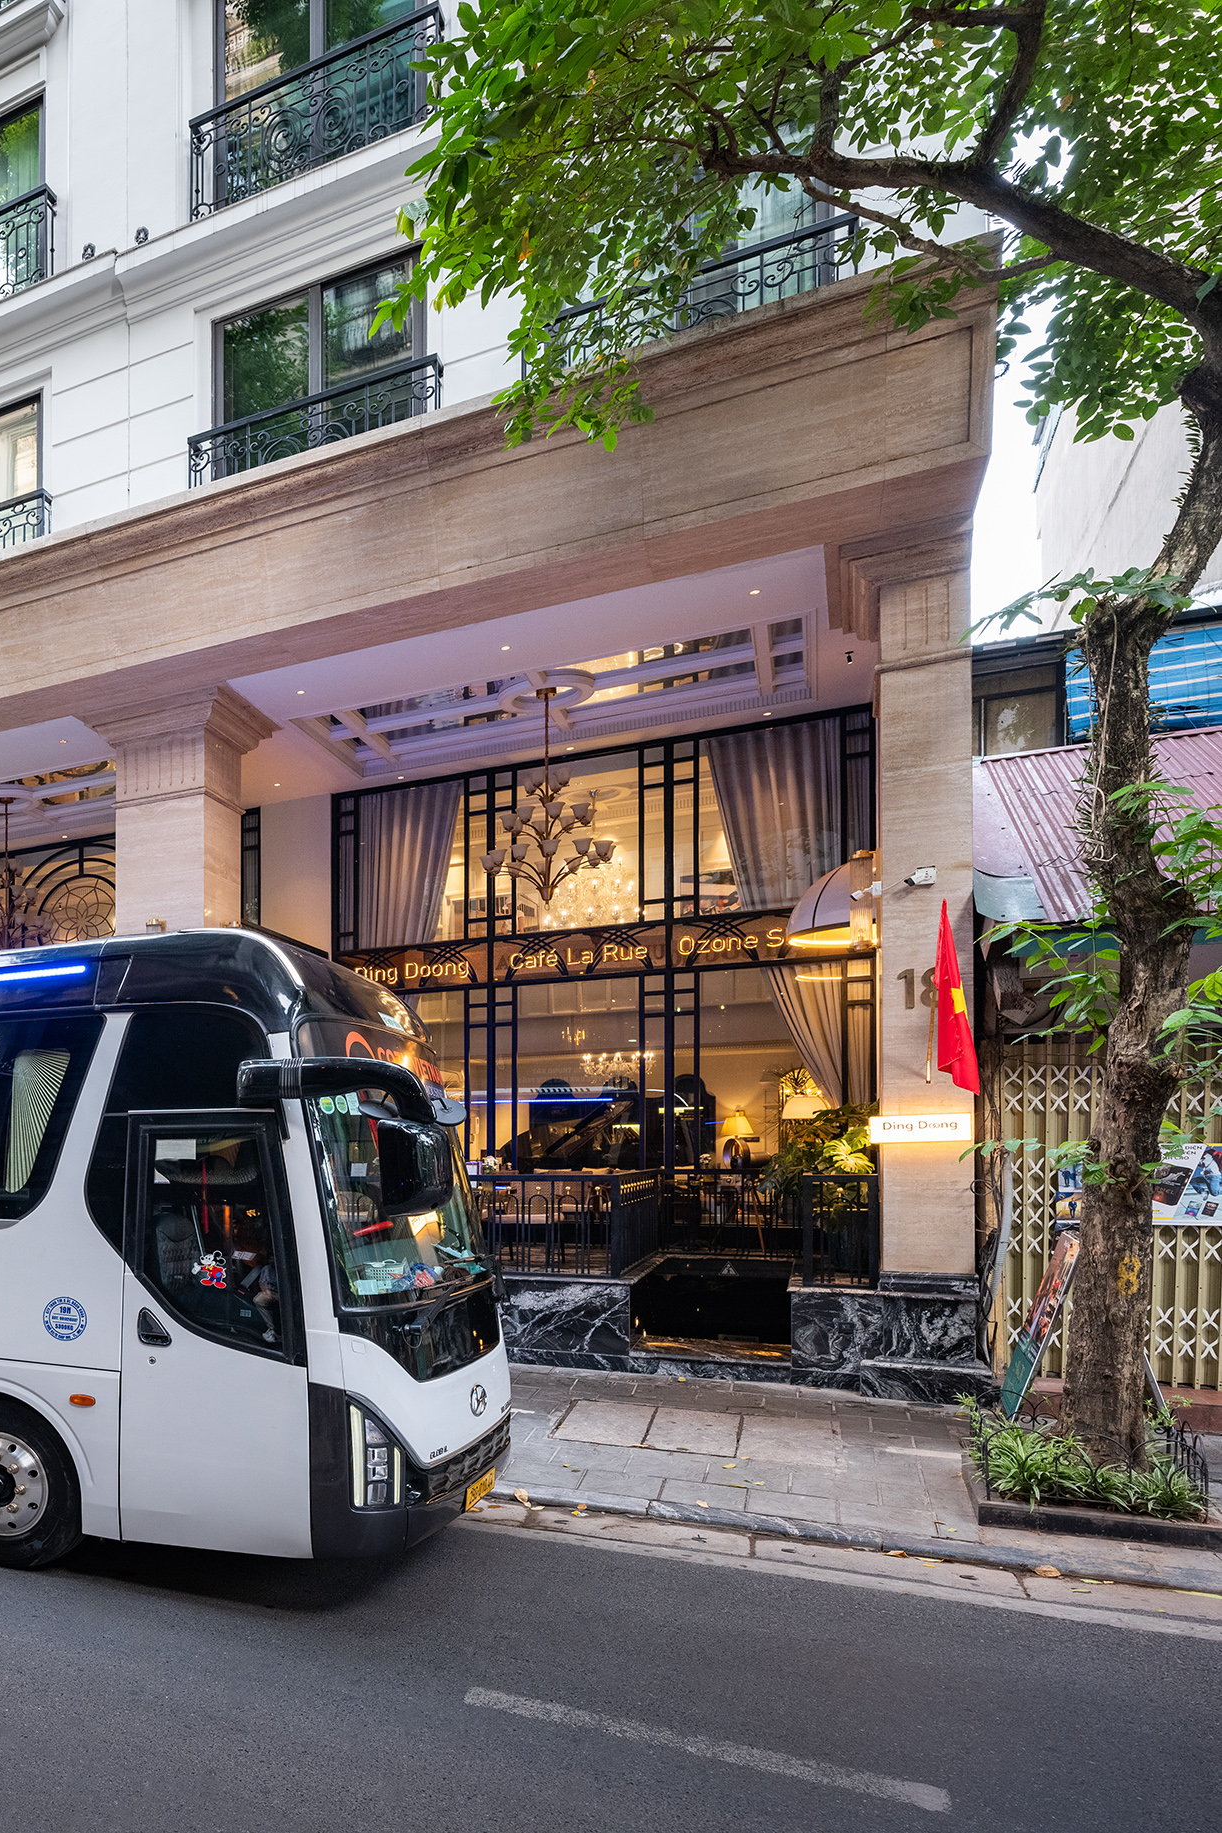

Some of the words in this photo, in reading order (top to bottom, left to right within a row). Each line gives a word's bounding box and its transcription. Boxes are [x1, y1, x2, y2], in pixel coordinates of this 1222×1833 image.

[678, 932, 759, 956] Ozone
[509, 947, 558, 971] Café
[566, 944, 594, 966] La
[602, 943, 649, 963] Rue
[405, 961, 470, 979] Doong
[883, 1122, 913, 1131] Ding
[918, 1120, 958, 1130] Doong
[1118, 1257, 1141, 1295] 8
